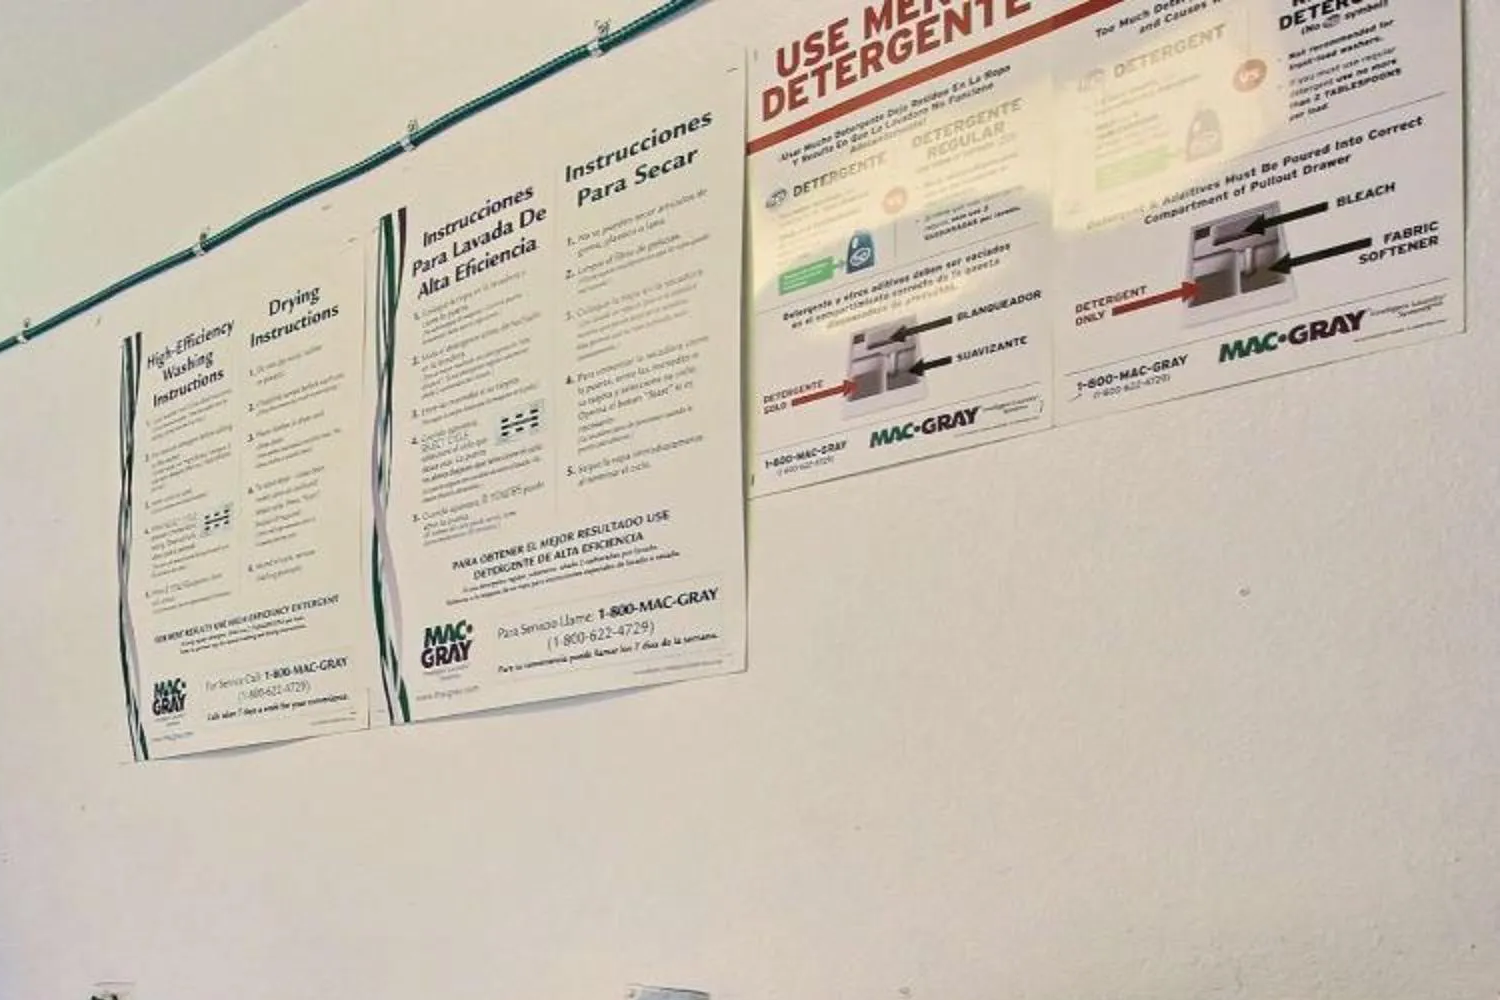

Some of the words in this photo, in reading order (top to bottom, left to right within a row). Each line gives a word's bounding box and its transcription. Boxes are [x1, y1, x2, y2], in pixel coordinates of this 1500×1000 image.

[1095, 24, 1114, 38] Too
[1119, 9, 1150, 28] Much
[1140, 17, 1160, 34] and
[1164, 0, 1206, 23] Causes
[776, 17, 849, 77] USE
[1114, 22, 1225, 79] DETERGENT
[1309, 23, 1376, 52] recommended
[762, 0, 1031, 121] DETERGENTE
[834, 112, 883, 139] Detergente
[984, 64, 1010, 80] Ropa
[1325, 67, 1400, 98] TABLESPOONS
[912, 96, 1022, 148] DETERGENTE
[927, 119, 1005, 160] REGULAR
[565, 111, 712, 183] Instrucciones
[1162, 180, 1220, 206] Additives
[1226, 166, 1256, 185] Must
[1261, 161, 1278, 174] Be
[1283, 143, 1330, 167] Poured
[1335, 134, 1361, 151] Into
[1368, 115, 1422, 141] Correct
[577, 177, 626, 208] Para
[634, 148, 699, 185] Secar
[794, 159, 886, 198] DETERGENTE
[1144, 190, 1228, 225] Compartment
[1233, 184, 1245, 197] of
[1250, 168, 1297, 192] Pullout
[1303, 153, 1350, 175] Drawer
[1336, 181, 1395, 208] BLEACH
[423, 186, 533, 248] Instrucciones
[1383, 220, 1438, 244] FABRIC
[412, 250, 447, 277] Para
[453, 219, 513, 258] Lavada
[519, 207, 547, 229] De
[1358, 234, 1438, 265] SOFTENER
[418, 274, 449, 300] Alta
[455, 236, 537, 283] Eficiencia
[269, 286, 320, 317] Drying
[957, 288, 1041, 322] BLANQUEADOR
[1075, 284, 1147, 313] DETERGENT
[1075, 309, 1104, 326] ONLY
[147, 318, 234, 369] High-Efficiency
[250, 304, 339, 348] Instructions
[162, 350, 213, 381] Washing
[956, 334, 1027, 362] SUAVIZANTE
[153, 368, 224, 408] Instructions
[763, 378, 822, 404] DETERGENTE
[1077, 353, 1187, 391] 1-800-MAC-GRAY
[763, 401, 786, 415] SOLO
[765, 439, 846, 469] 1-800-MAC-GRAY
[452, 556, 477, 570] PARA
[480, 544, 524, 564] OBTENER
[527, 541, 536, 552] EL
[540, 531, 574, 548] MEJOR
[577, 515, 643, 539] RESULTADO
[647, 508, 669, 523] USE
[473, 556, 534, 580] DETERGENTE
[537, 552, 550, 565] DE
[554, 545, 578, 560] ALTA
[581, 531, 643, 554] EFICIENCIA
[497, 626, 518, 639] Para
[520, 618, 558, 635] Servicio
[598, 586, 718, 620] 1-800-MAC-GRAY
[547, 619, 655, 649] (1-800-622-4729)
[264, 656, 347, 680] 1-800-MAC-GRAY
[421, 638, 472, 669] GRAY
[152, 692, 186, 716] GRAY
